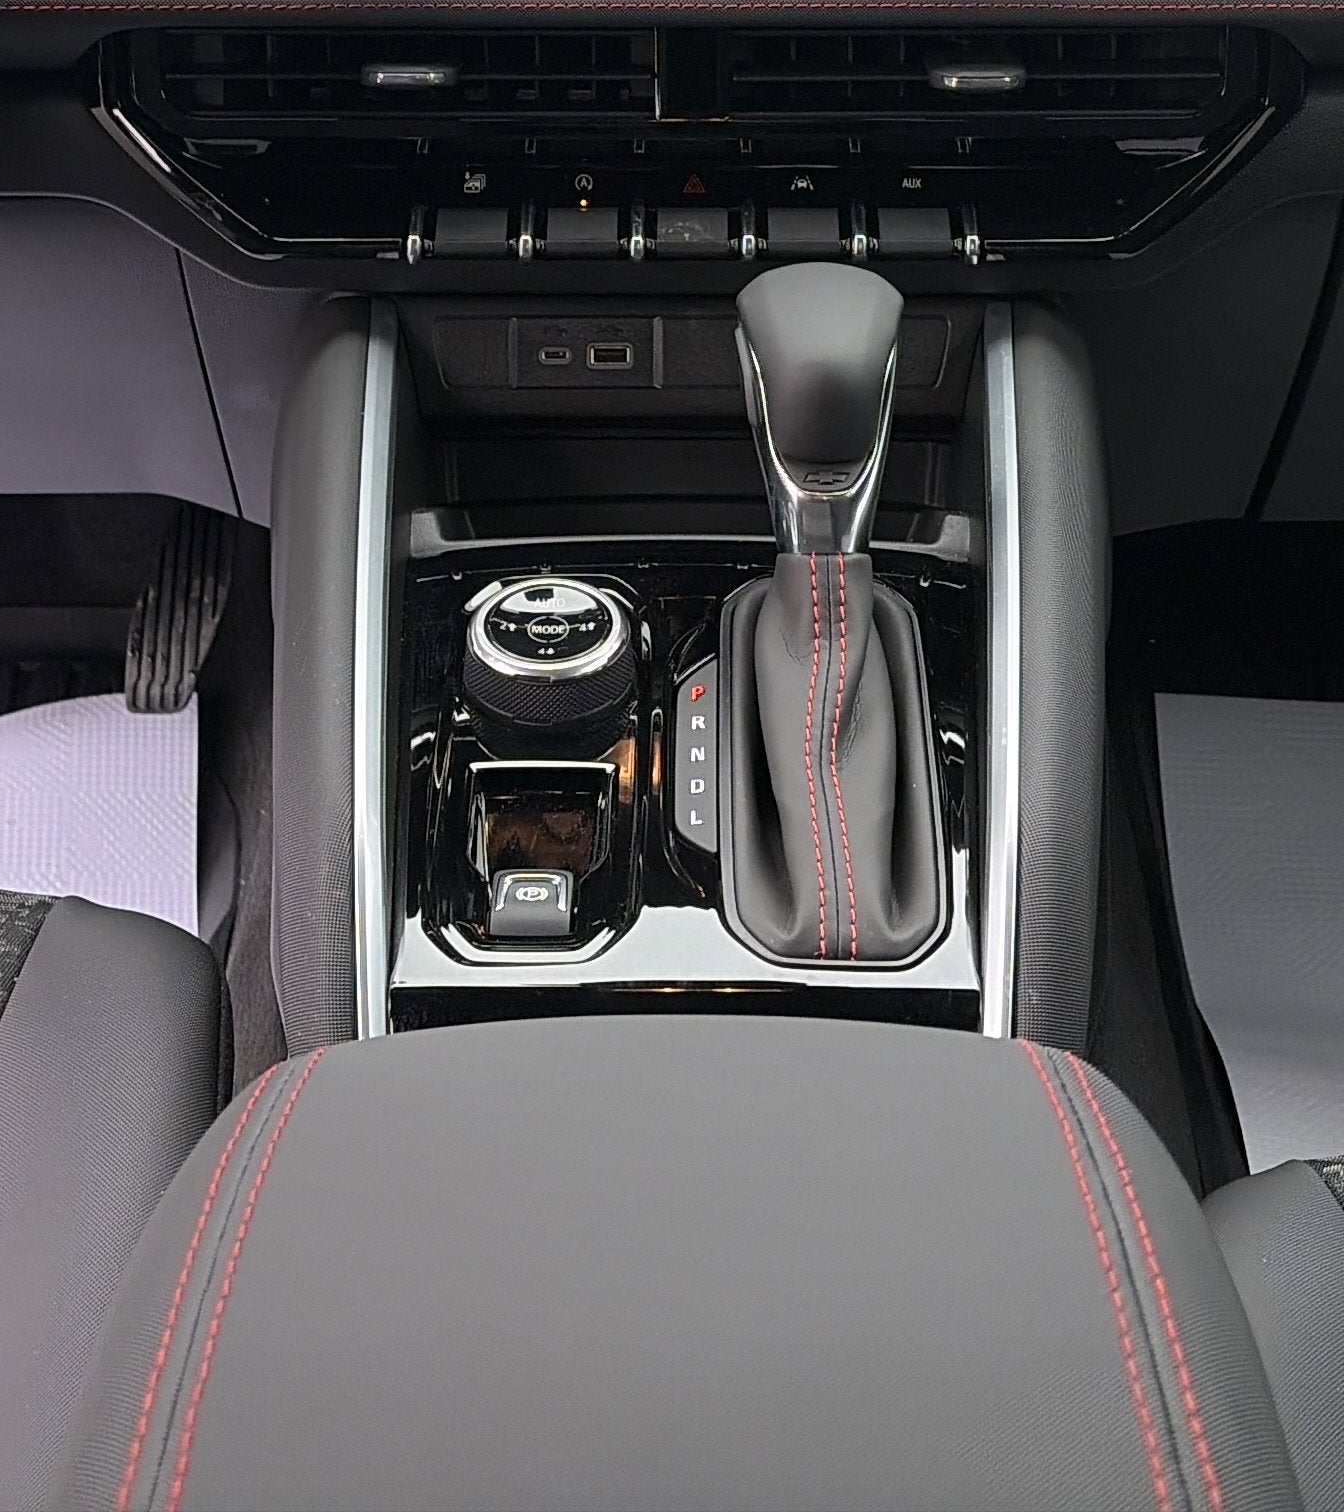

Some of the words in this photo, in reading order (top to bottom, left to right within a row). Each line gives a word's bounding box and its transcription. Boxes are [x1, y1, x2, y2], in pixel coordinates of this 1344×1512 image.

[902, 177, 922, 189] AUX
[534, 597, 566, 609] AUTO
[531, 624, 566, 635] MODE
[691, 684, 705, 702] P
[690, 715, 706, 731] R
[690, 746, 705, 763] N
[690, 778, 705, 795] D
[690, 810, 704, 826] L
